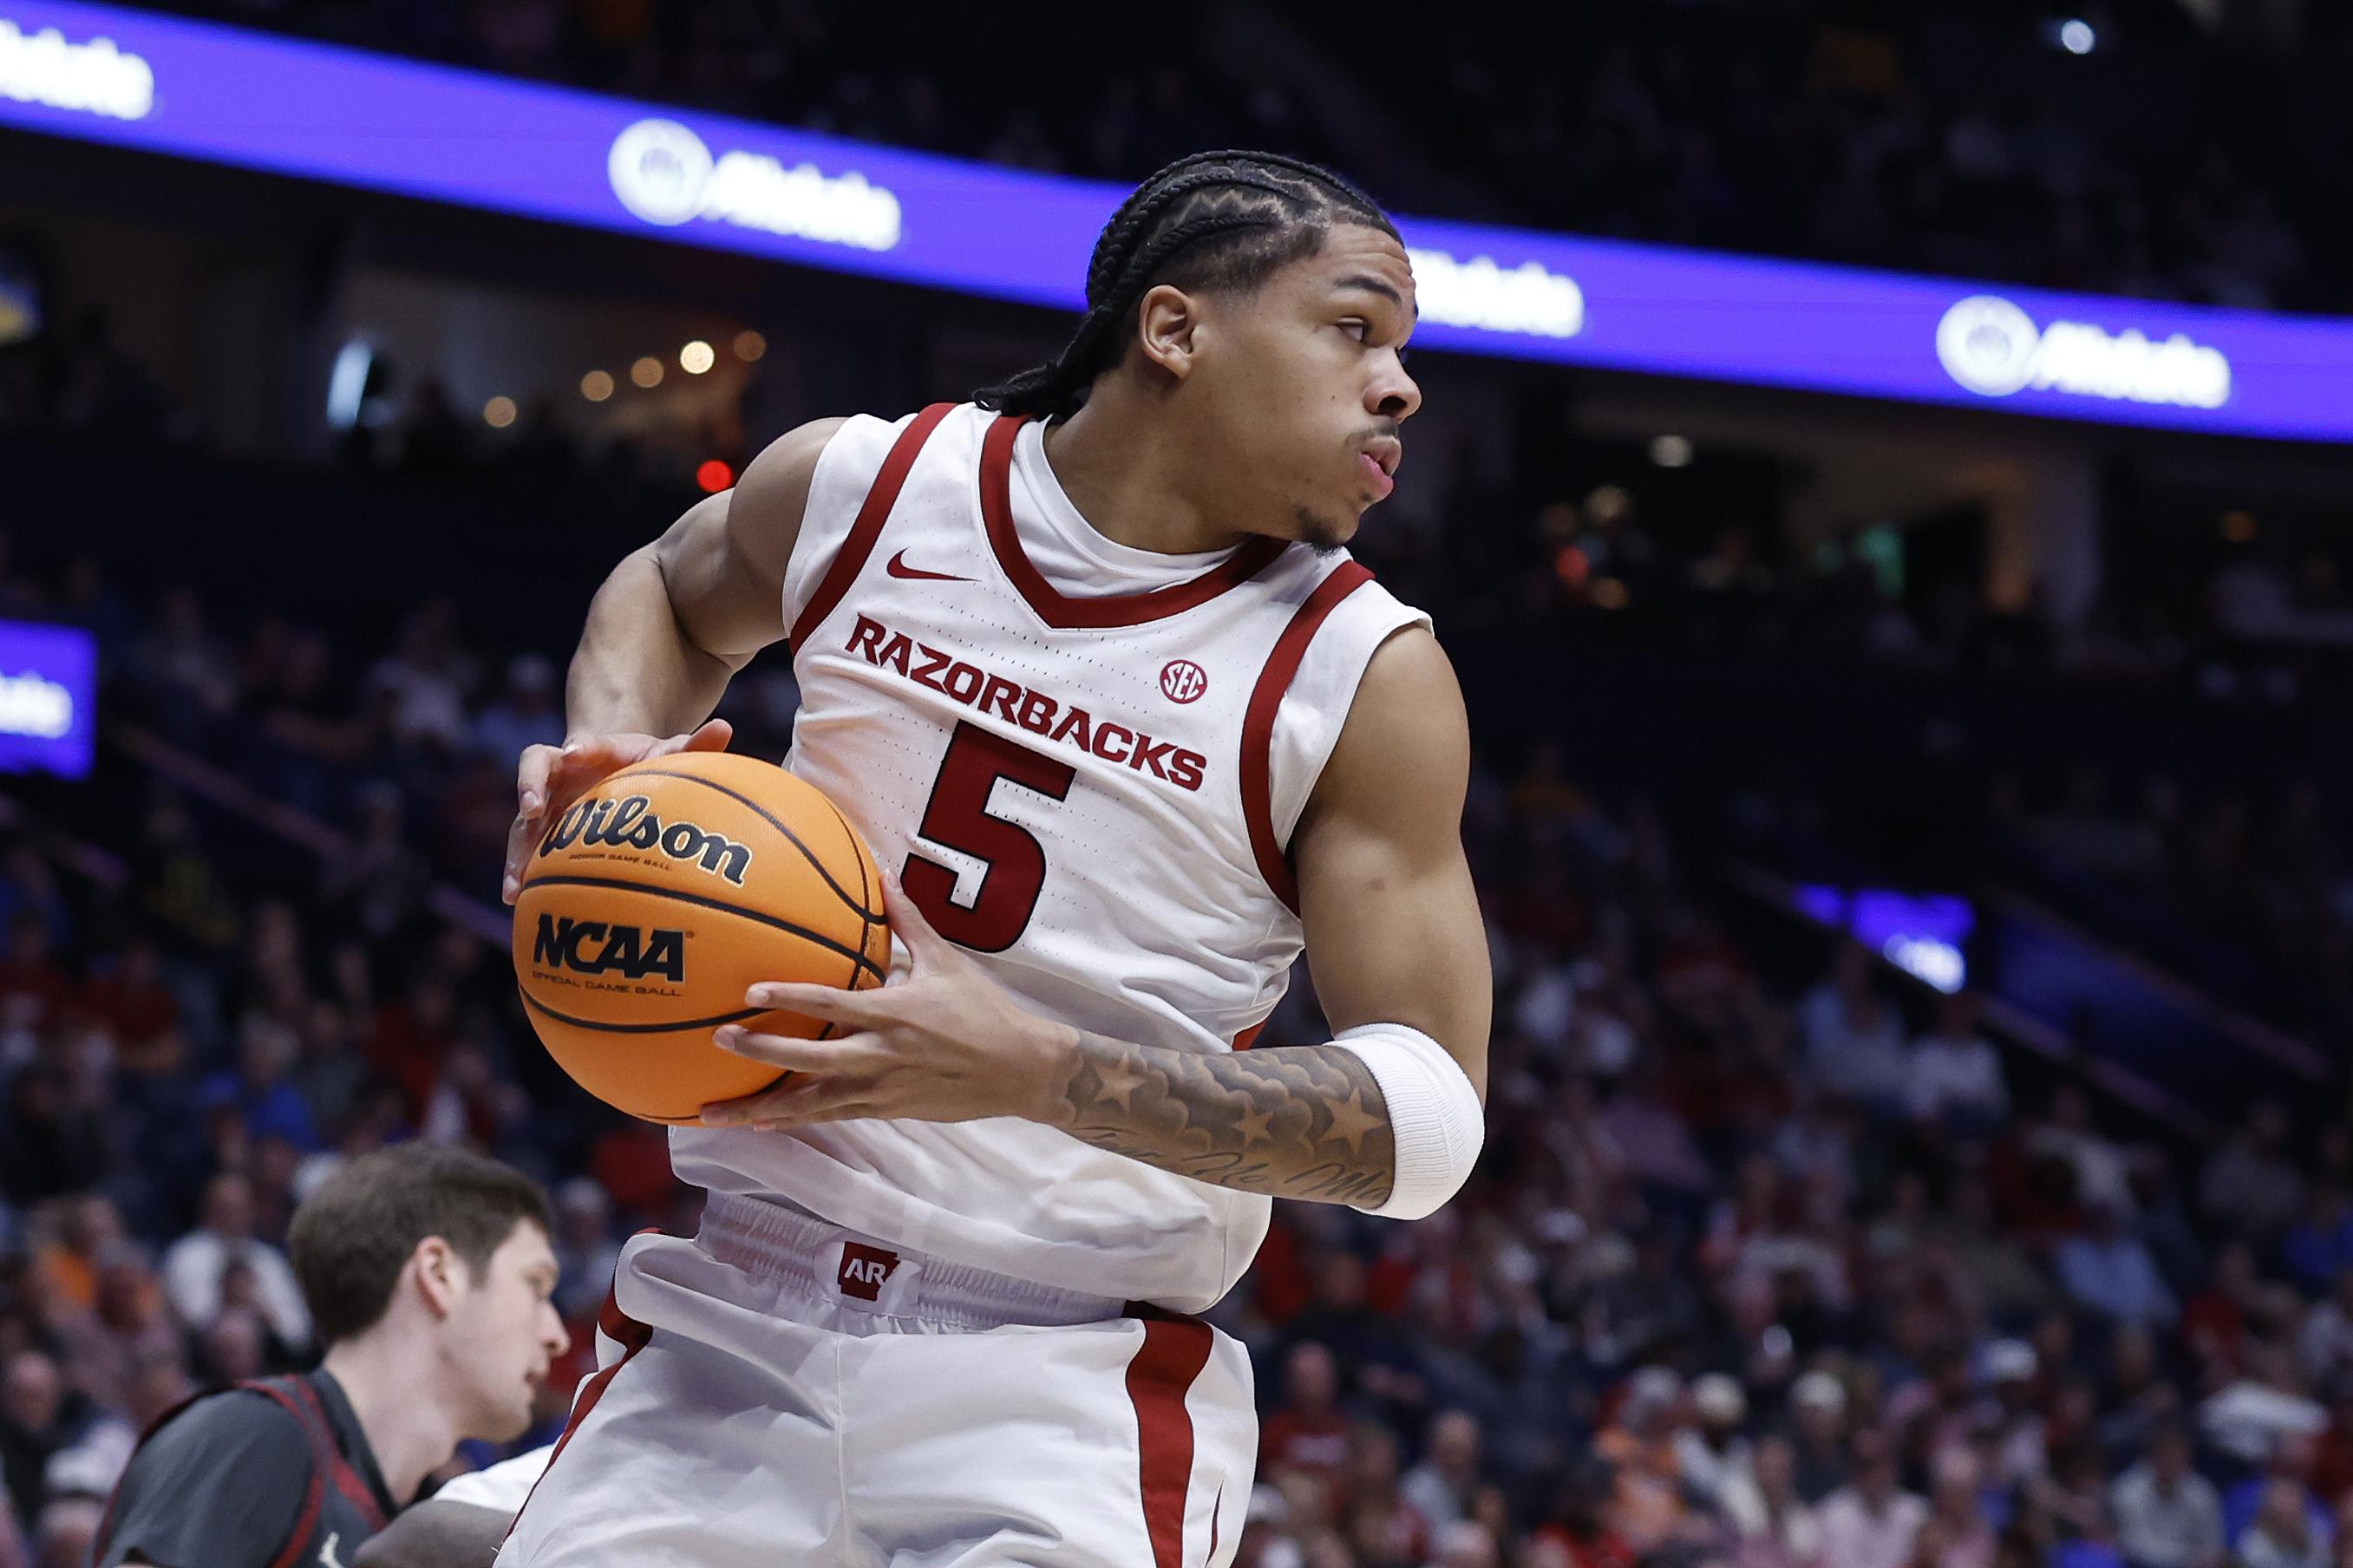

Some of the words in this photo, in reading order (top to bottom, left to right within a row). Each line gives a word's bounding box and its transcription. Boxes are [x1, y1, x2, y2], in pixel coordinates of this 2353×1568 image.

[845, 612, 1207, 791] RAZORBACKS
[1163, 662, 1205, 701] SEC
[539, 794, 753, 888] Wilson
[899, 718, 1078, 953] 5
[533, 912, 684, 982] NCAA
[585, 980, 630, 994] GAME
[635, 985, 683, 997] BALL
[843, 1258, 886, 1285] AR
